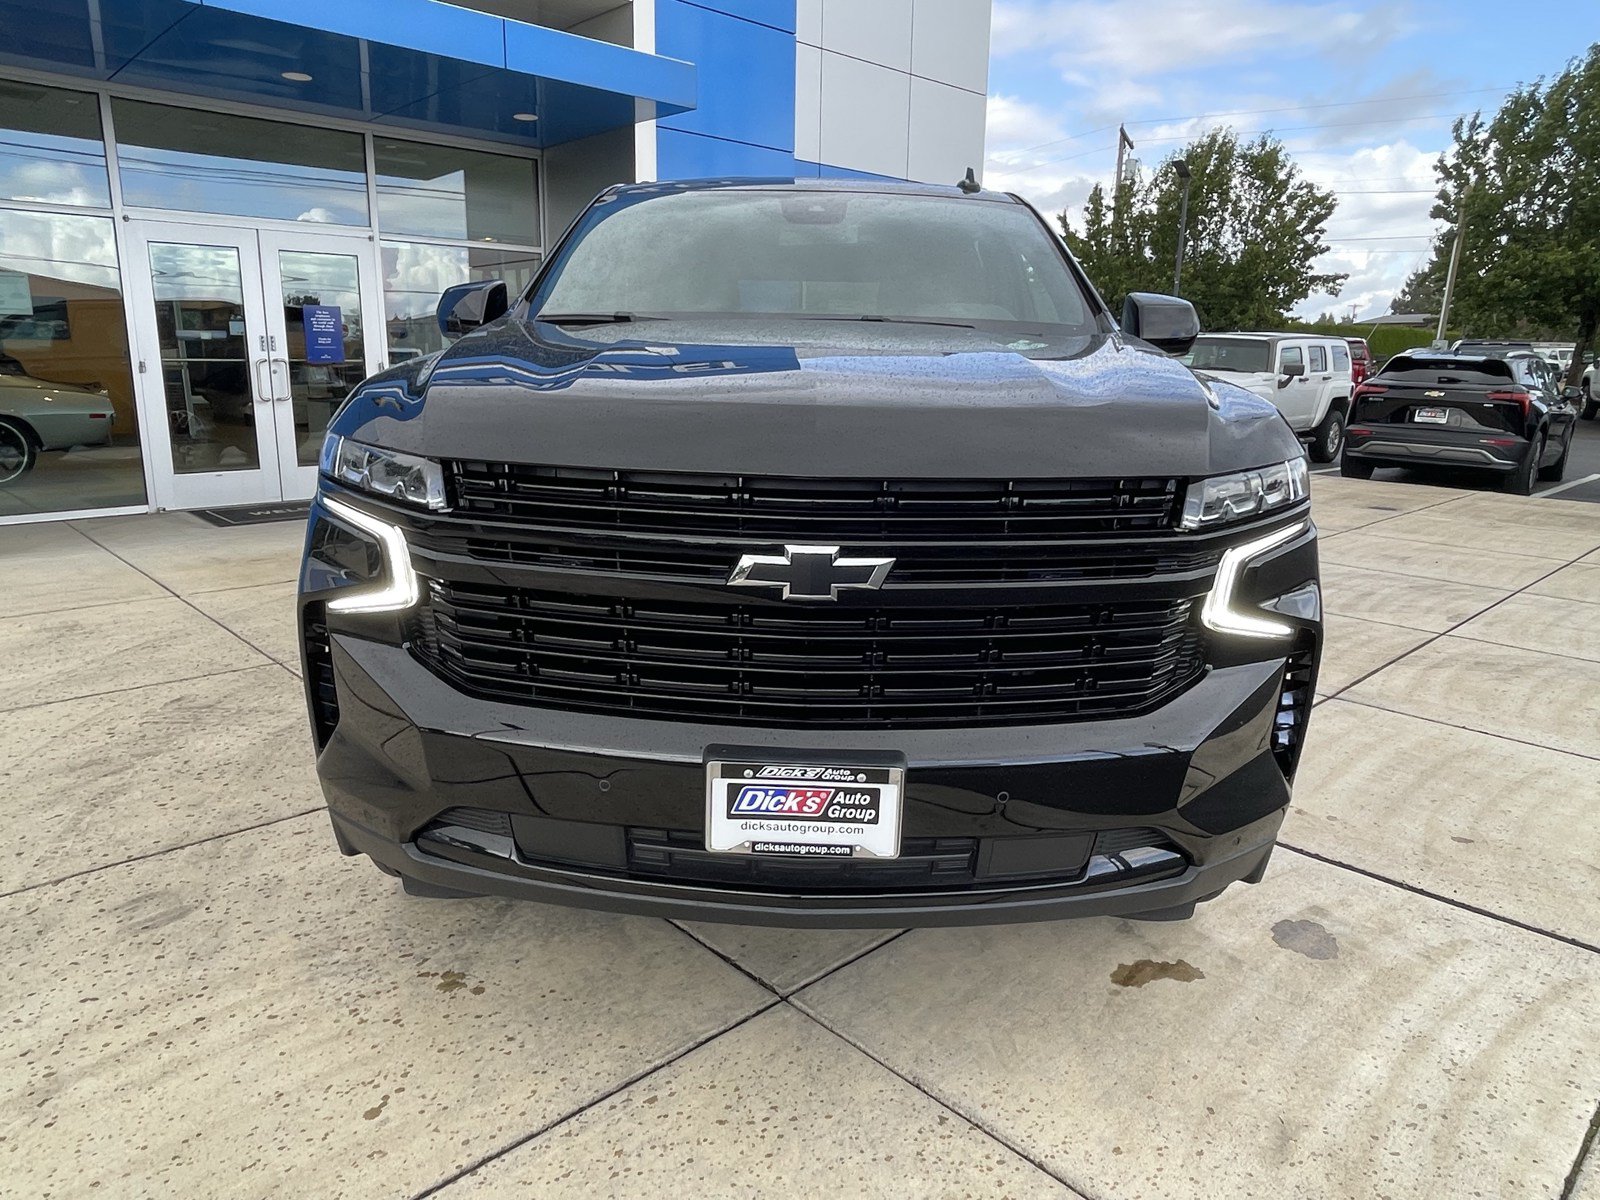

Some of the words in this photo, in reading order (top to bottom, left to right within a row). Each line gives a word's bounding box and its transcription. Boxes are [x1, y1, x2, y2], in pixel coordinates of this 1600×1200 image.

[821, 774, 855, 782] Group
[823, 768, 851, 776] Auto
[832, 791, 871, 805] Auto
[827, 806, 876, 822] Group
[740, 821, 865, 835] dicksautogroup.com
[754, 843, 850, 855] dicksautogroup.com
